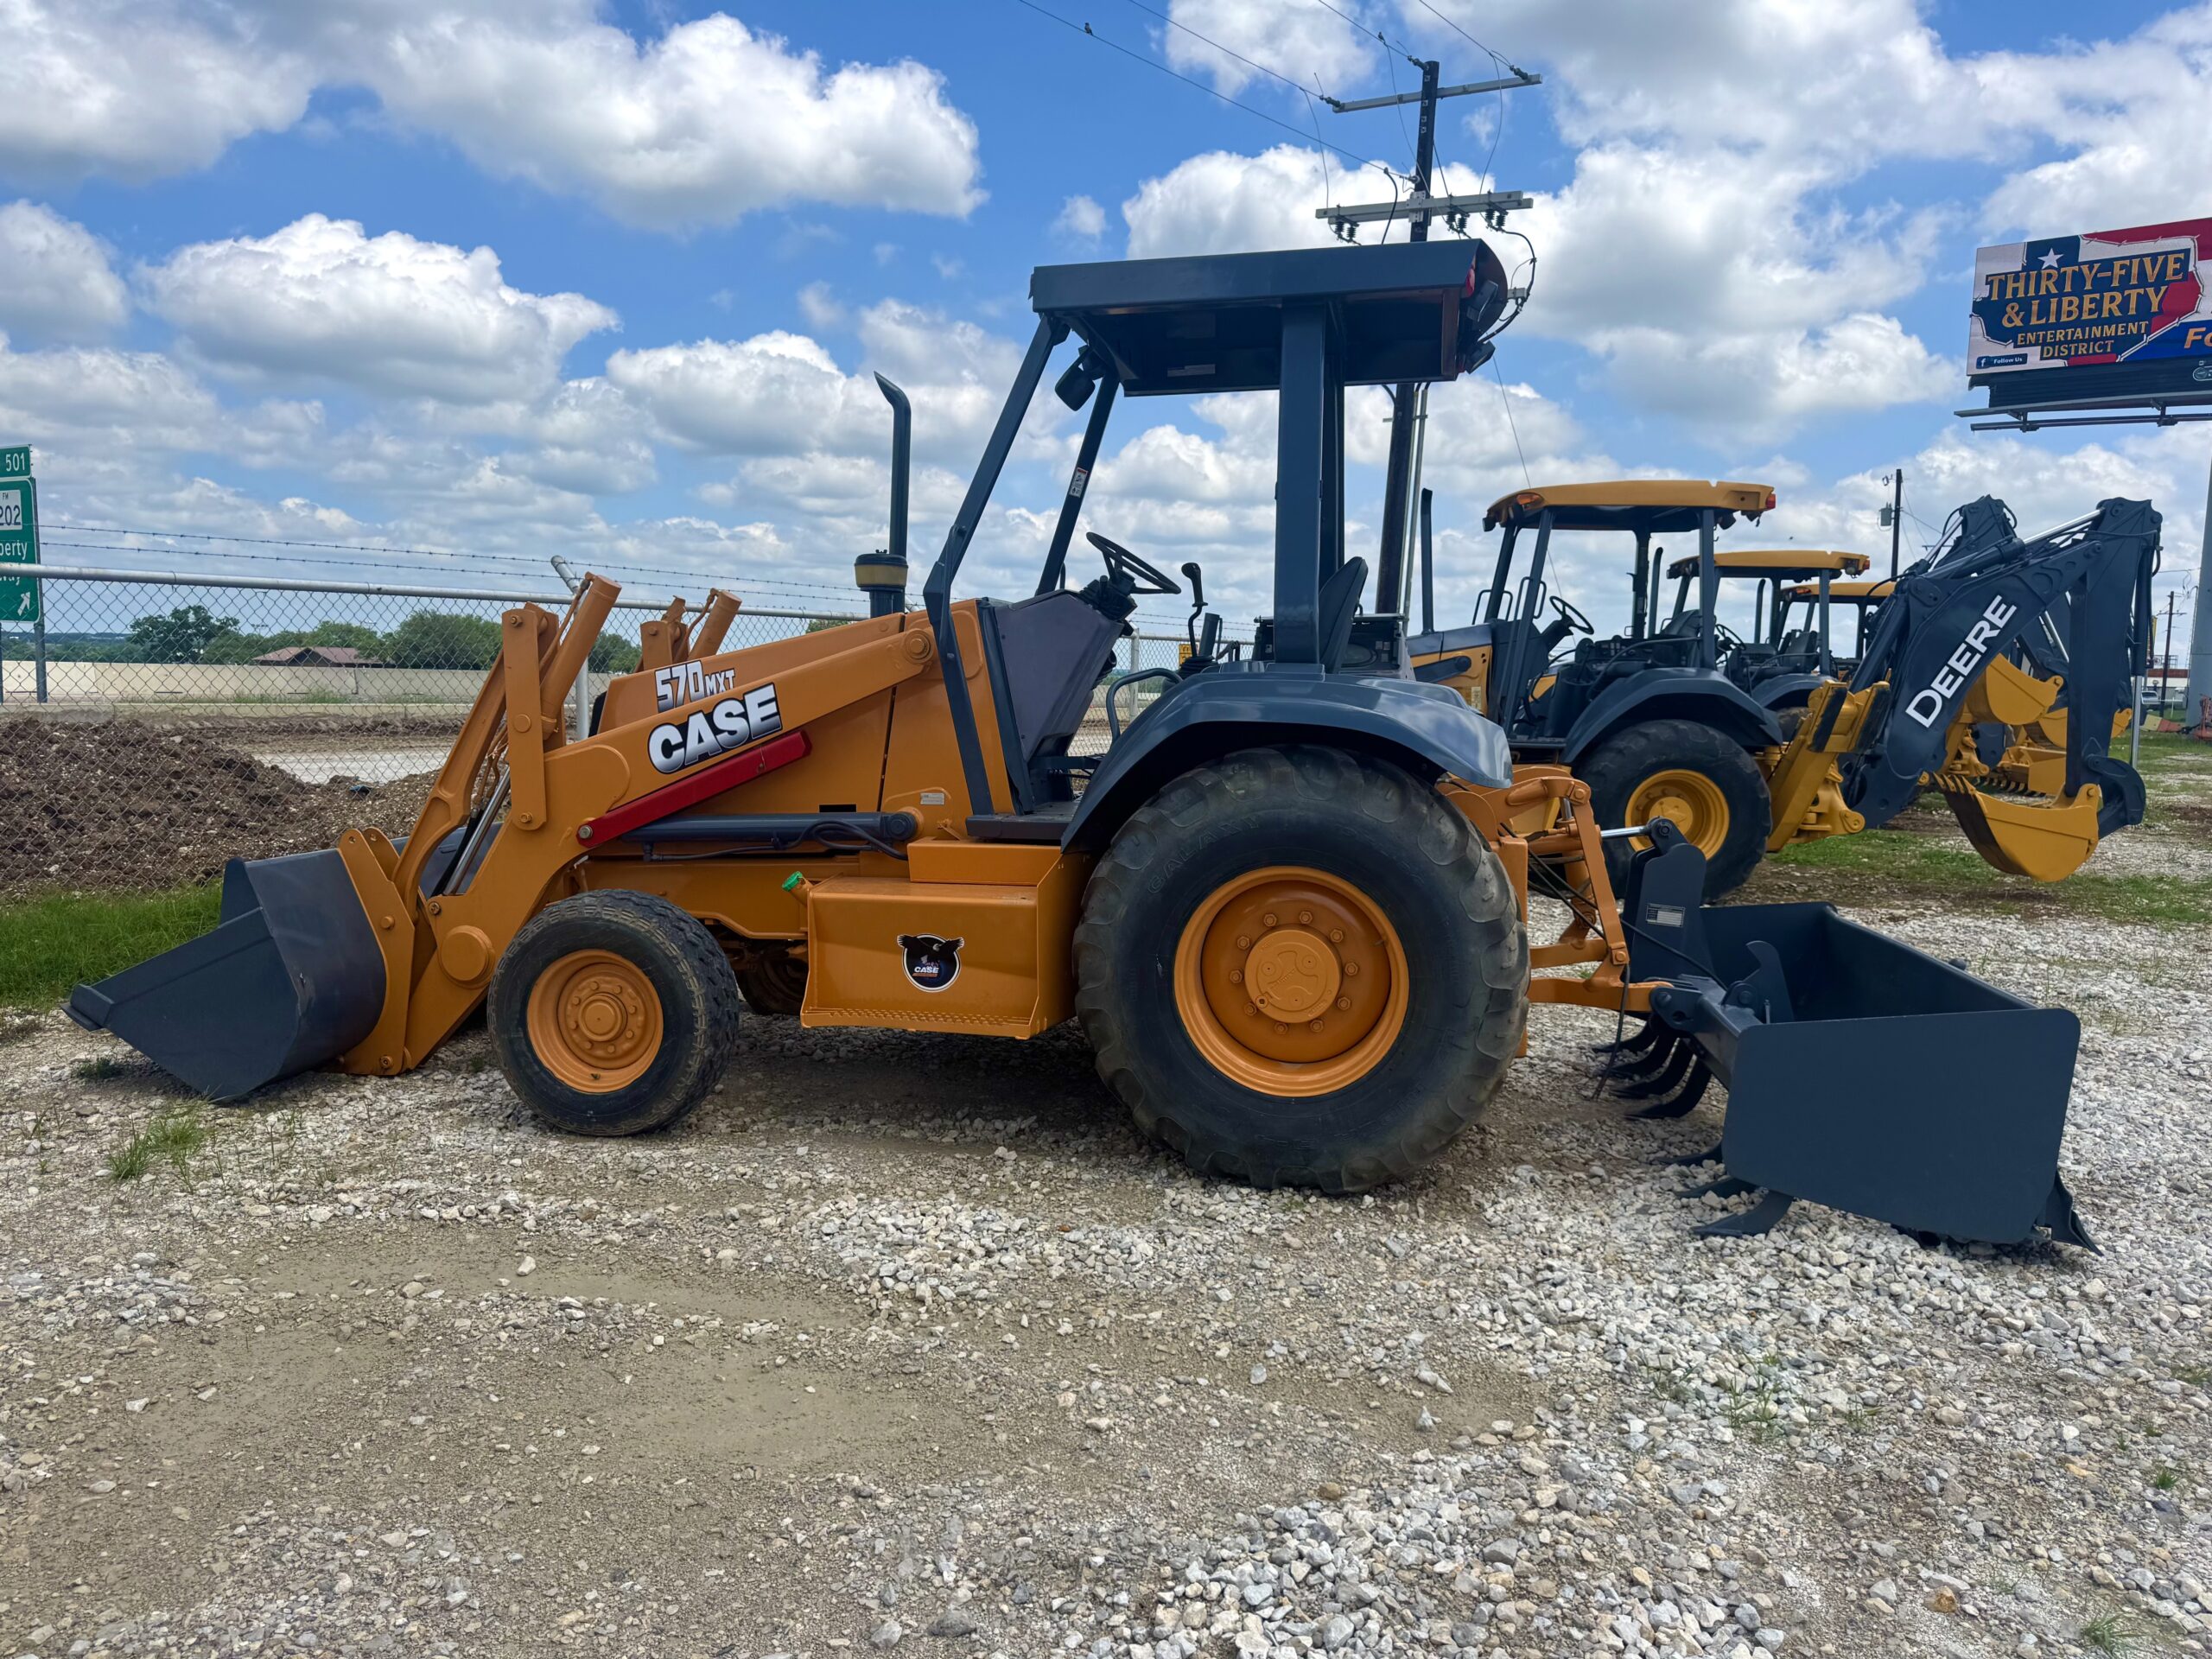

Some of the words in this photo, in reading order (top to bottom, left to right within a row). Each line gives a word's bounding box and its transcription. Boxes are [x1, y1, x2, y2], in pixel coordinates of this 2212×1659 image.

[1987, 252, 2185, 302] THIRTY-FIVE
[2001, 302, 2025, 328] &
[2030, 286, 2168, 326] LIBERTY
[2017, 321, 2149, 346] ENTERTAINMENT
[2042, 340, 2115, 359] DISTRICT
[5, 452, 25, 472] 501
[2, 492, 9, 500] FM
[1904, 594, 2018, 728] DEERE
[647, 681, 784, 775] CASE
[1147, 814, 1262, 894] GALAXY
